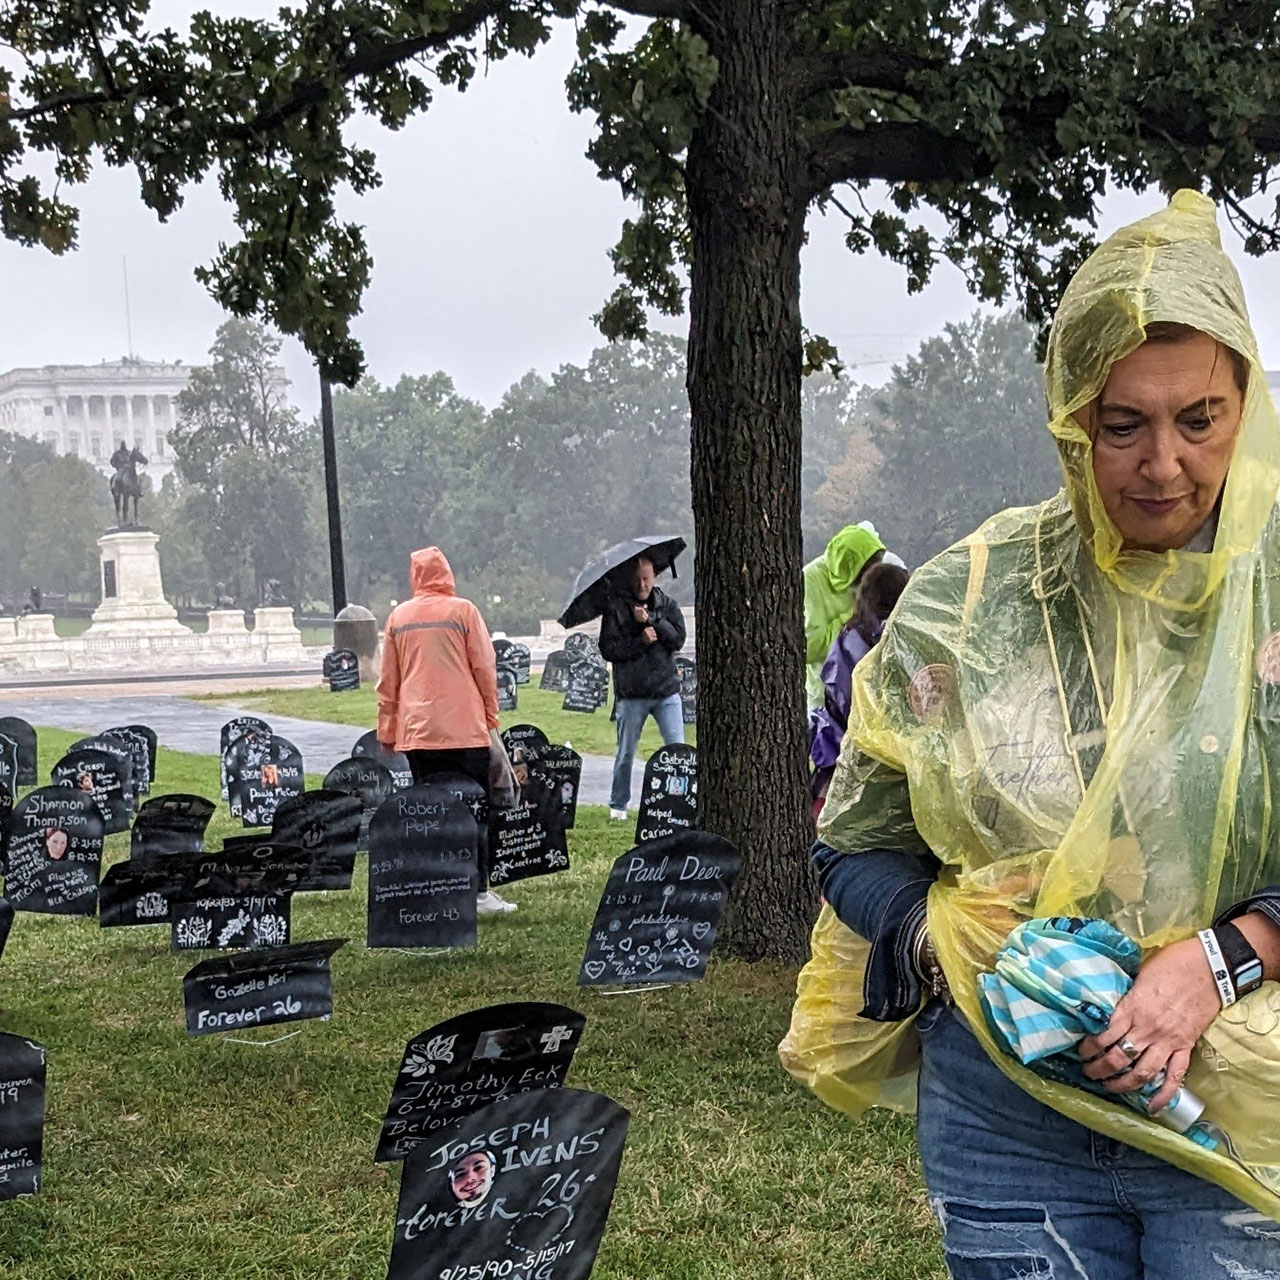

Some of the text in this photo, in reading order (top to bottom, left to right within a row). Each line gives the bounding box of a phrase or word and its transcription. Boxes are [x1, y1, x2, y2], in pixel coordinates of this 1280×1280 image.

[26, 795, 84, 814] Shannon
[393, 795, 450, 816] Robert
[23, 815, 87, 827] Thompson
[401, 818, 440, 838] Pope
[625, 856, 724, 883] Paul Deer
[400, 908, 459, 924] Forever 43
[197, 995, 302, 1029] Forever 26
[0, 1087, 20, 1104] 19
[401, 1072, 515, 1101] Timothy
[424, 1115, 551, 1173] JOSEPH
[500, 1127, 606, 1173] IVENS
